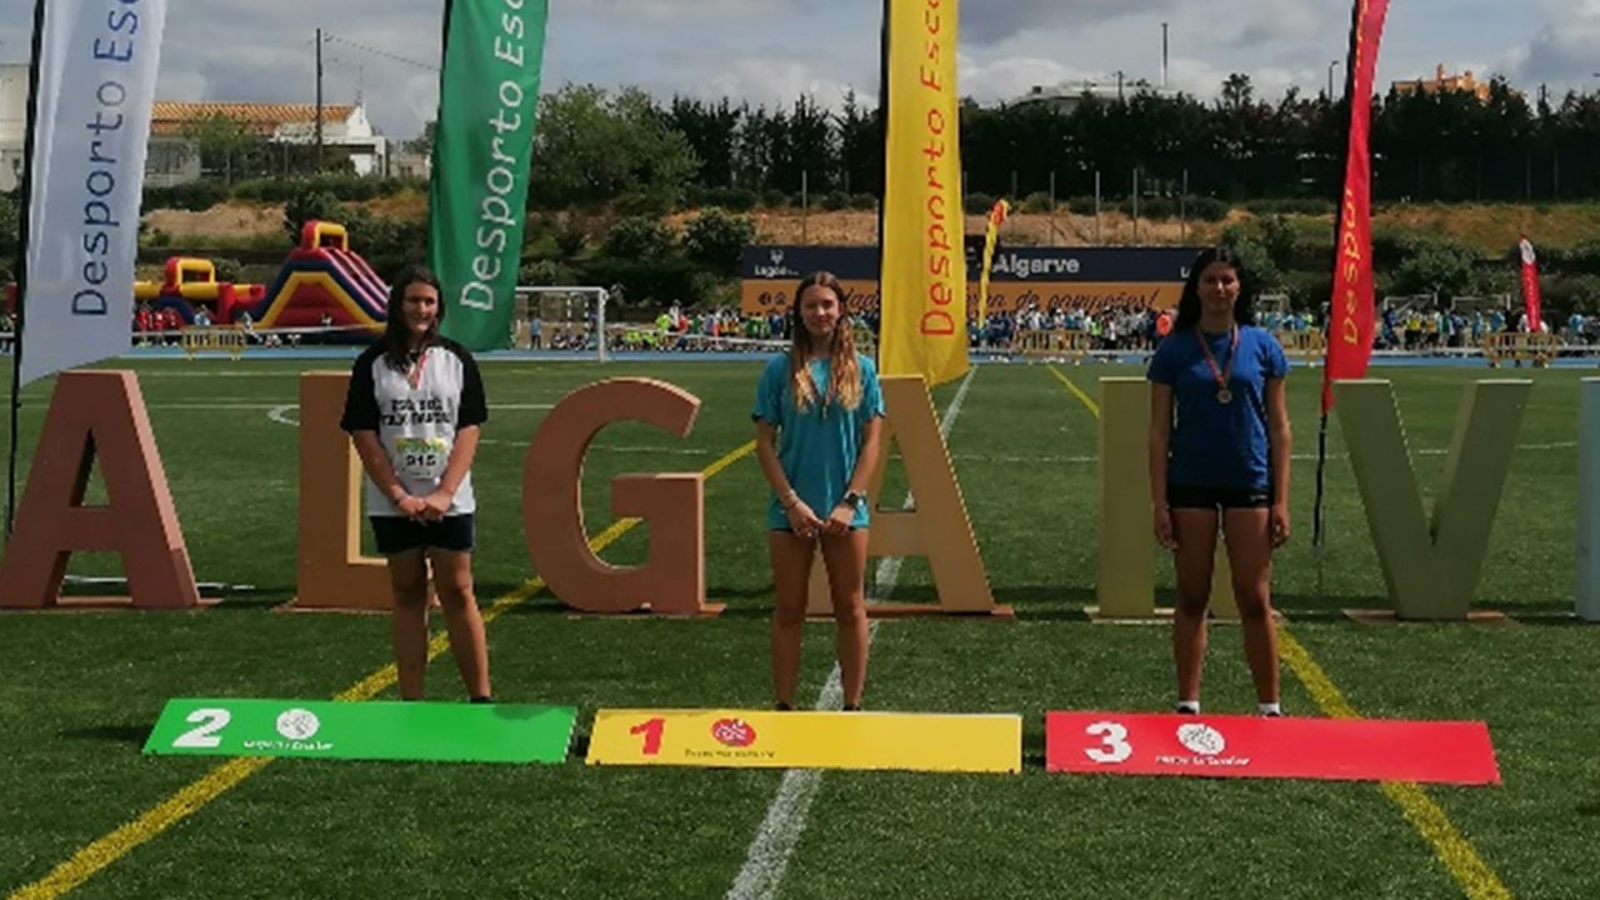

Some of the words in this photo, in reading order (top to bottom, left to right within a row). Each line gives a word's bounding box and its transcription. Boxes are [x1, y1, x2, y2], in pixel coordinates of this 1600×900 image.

[94, 0, 138, 62] Es
[72, 81, 126, 315] Desporto
[459, 80, 523, 310] Desporto
[920, 108, 955, 336] Desporto
[993, 253, 1081, 278] Algarve
[171, 708, 231, 748] 2
[629, 718, 666, 755] 1
[1085, 721, 1133, 763] 3
